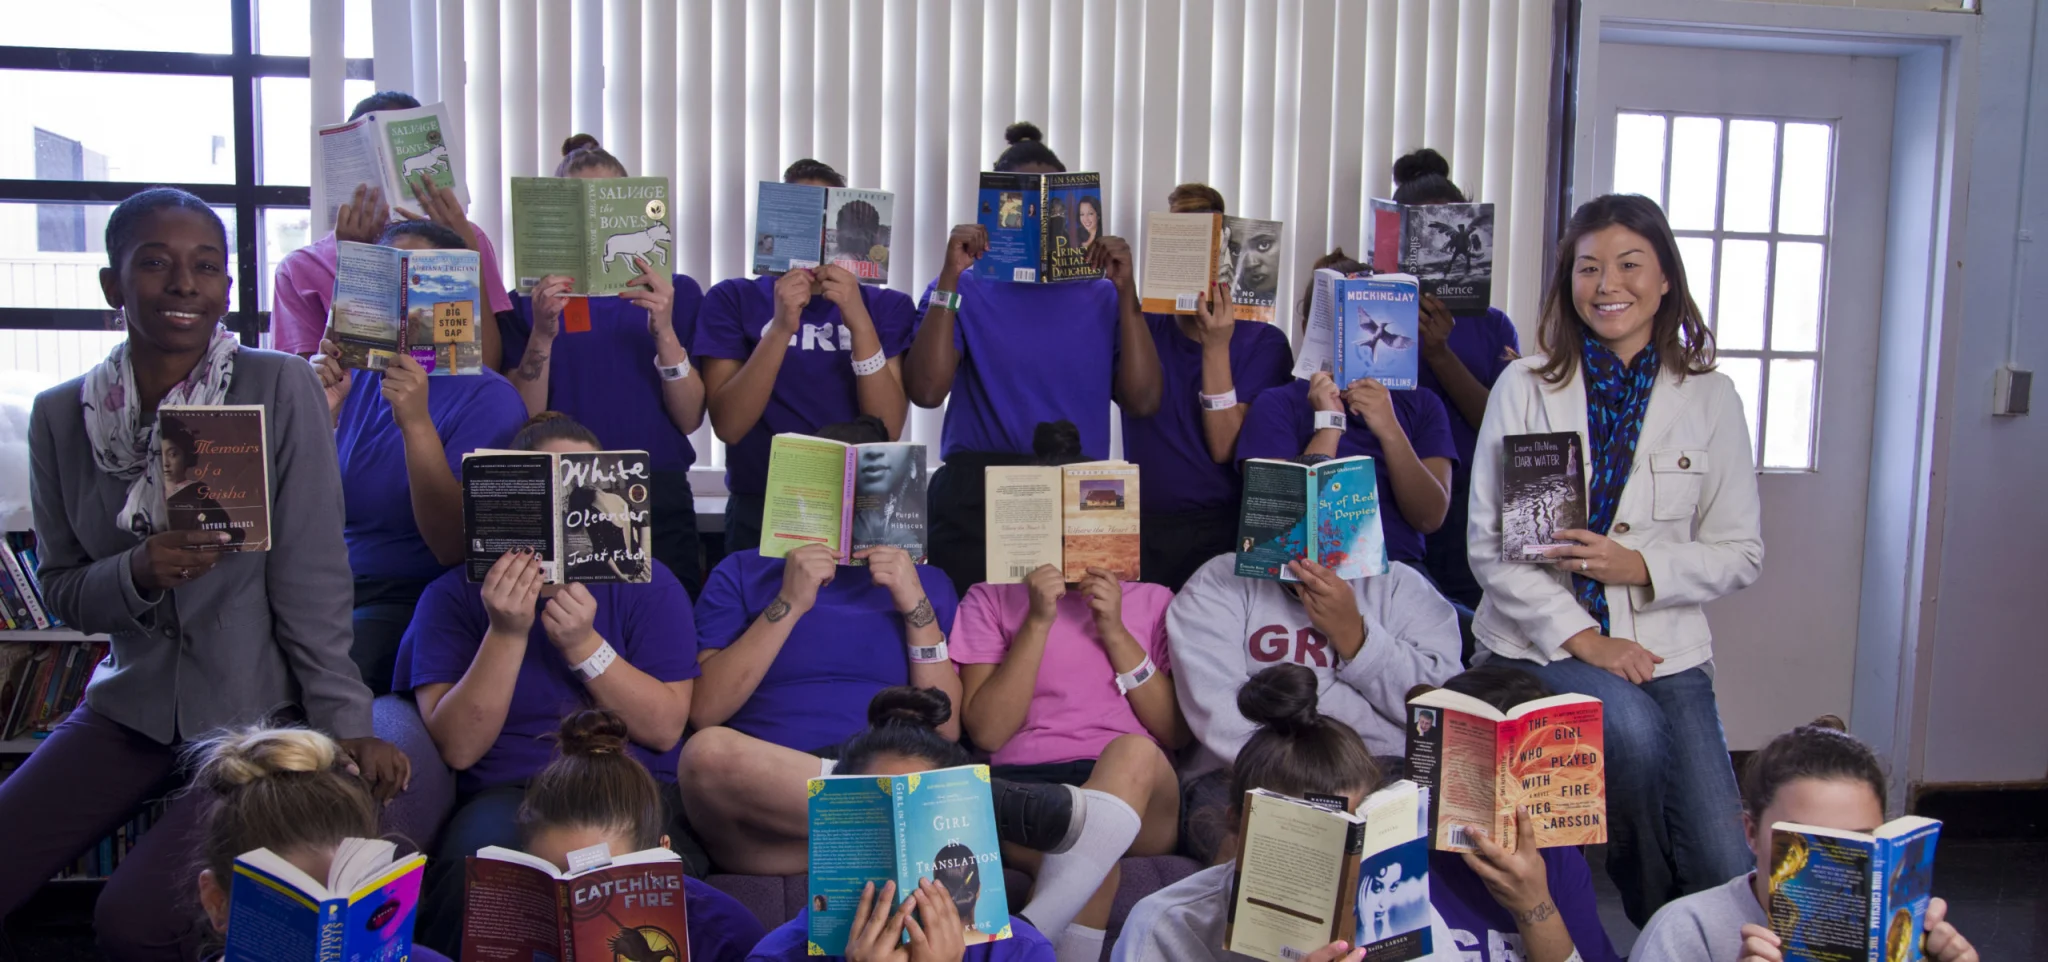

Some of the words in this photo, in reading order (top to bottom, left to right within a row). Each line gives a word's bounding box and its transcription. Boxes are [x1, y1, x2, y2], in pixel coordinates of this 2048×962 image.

[391, 120, 438, 136] SALVAGE
[396, 143, 430, 156] BONES
[1066, 174, 1100, 183] SASSON
[600, 186, 665, 200] SALVAGE
[600, 204, 614, 212] the
[600, 216, 648, 228] BONES
[1056, 236, 1088, 257] PRINC
[1052, 252, 1088, 268] SULTA
[1410, 236, 1421, 273] silence
[1052, 266, 1101, 278] DAUGHTERS
[1347, 291, 1415, 302] MOCKINGJAY
[1436, 284, 1474, 295] silence
[445, 308, 460, 317] BIG
[444, 329, 462, 337] GAP
[1382, 378, 1411, 387] COLLINS
[194, 439, 260, 454] Memoirs
[1514, 444, 1532, 452] Laura
[1515, 456, 1532, 468] DARK
[1535, 454, 1560, 467] WATER
[194, 462, 209, 480] of
[212, 468, 222, 476] a
[560, 457, 648, 488] White
[197, 485, 246, 500] Geisha
[1319, 501, 1332, 510] Sky
[1336, 495, 1349, 506] of
[1352, 492, 1374, 504] Red
[566, 508, 648, 528] Oleander
[568, 549, 609, 566] Janet
[613, 548, 647, 562] Fitch
[1249, 624, 1340, 668] GR
[1529, 716, 1548, 732] THE
[1554, 727, 1583, 740] GIRL
[1520, 747, 1543, 762] WHO
[1551, 753, 1597, 768] PLAYED
[1522, 775, 1550, 790] WITH
[896, 782, 904, 808] GIRL
[1561, 784, 1590, 797] FIRE
[898, 810, 904, 818] IN
[1526, 802, 1551, 816] TIEG
[933, 816, 970, 831] GIRL
[1544, 814, 1600, 830] LARSSON
[898, 822, 909, 878] TRANSLATION
[947, 838, 960, 848] IN
[916, 852, 998, 874] TRANSLATION
[1872, 871, 1882, 890] JOHN
[574, 871, 680, 906] CATCHING
[624, 892, 674, 909] FIRE
[1870, 892, 1881, 929] GRISHAM
[964, 921, 992, 932] KWOK
[330, 922, 344, 962] SISTE
[1368, 944, 1383, 953] Nella
[1385, 936, 1408, 948] LARSEN
